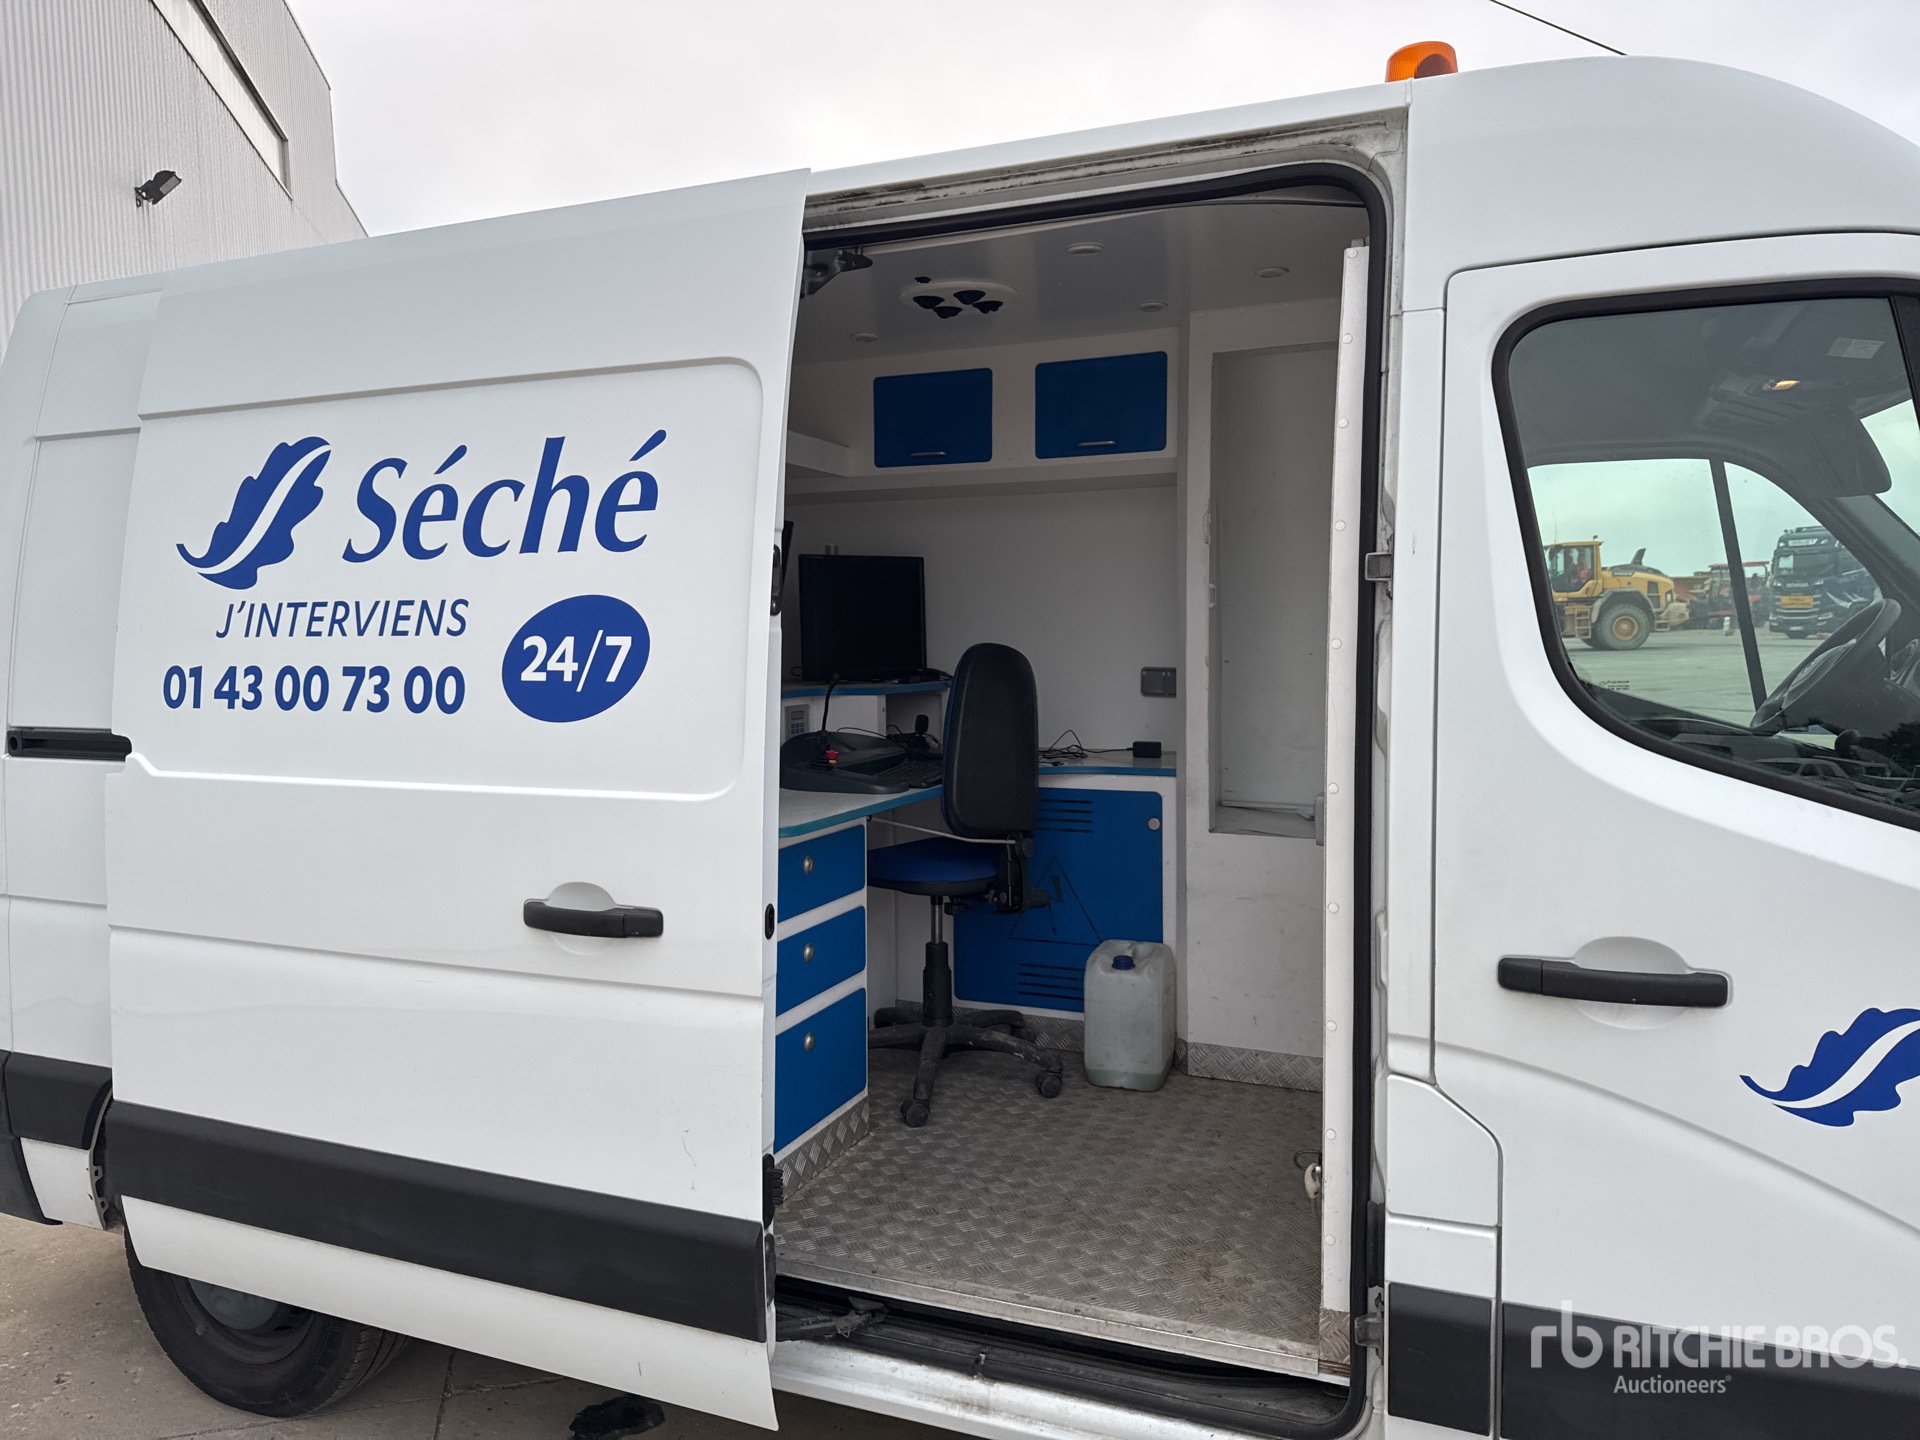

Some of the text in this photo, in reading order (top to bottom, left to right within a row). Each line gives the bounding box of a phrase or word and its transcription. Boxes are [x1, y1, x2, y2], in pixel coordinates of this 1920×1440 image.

[342, 429, 667, 564] Séché
[215, 599, 469, 639] J'INTERVIENS
[520, 630, 632, 692] 24/7
[163, 665, 465, 715] 01 43 00 73 00
